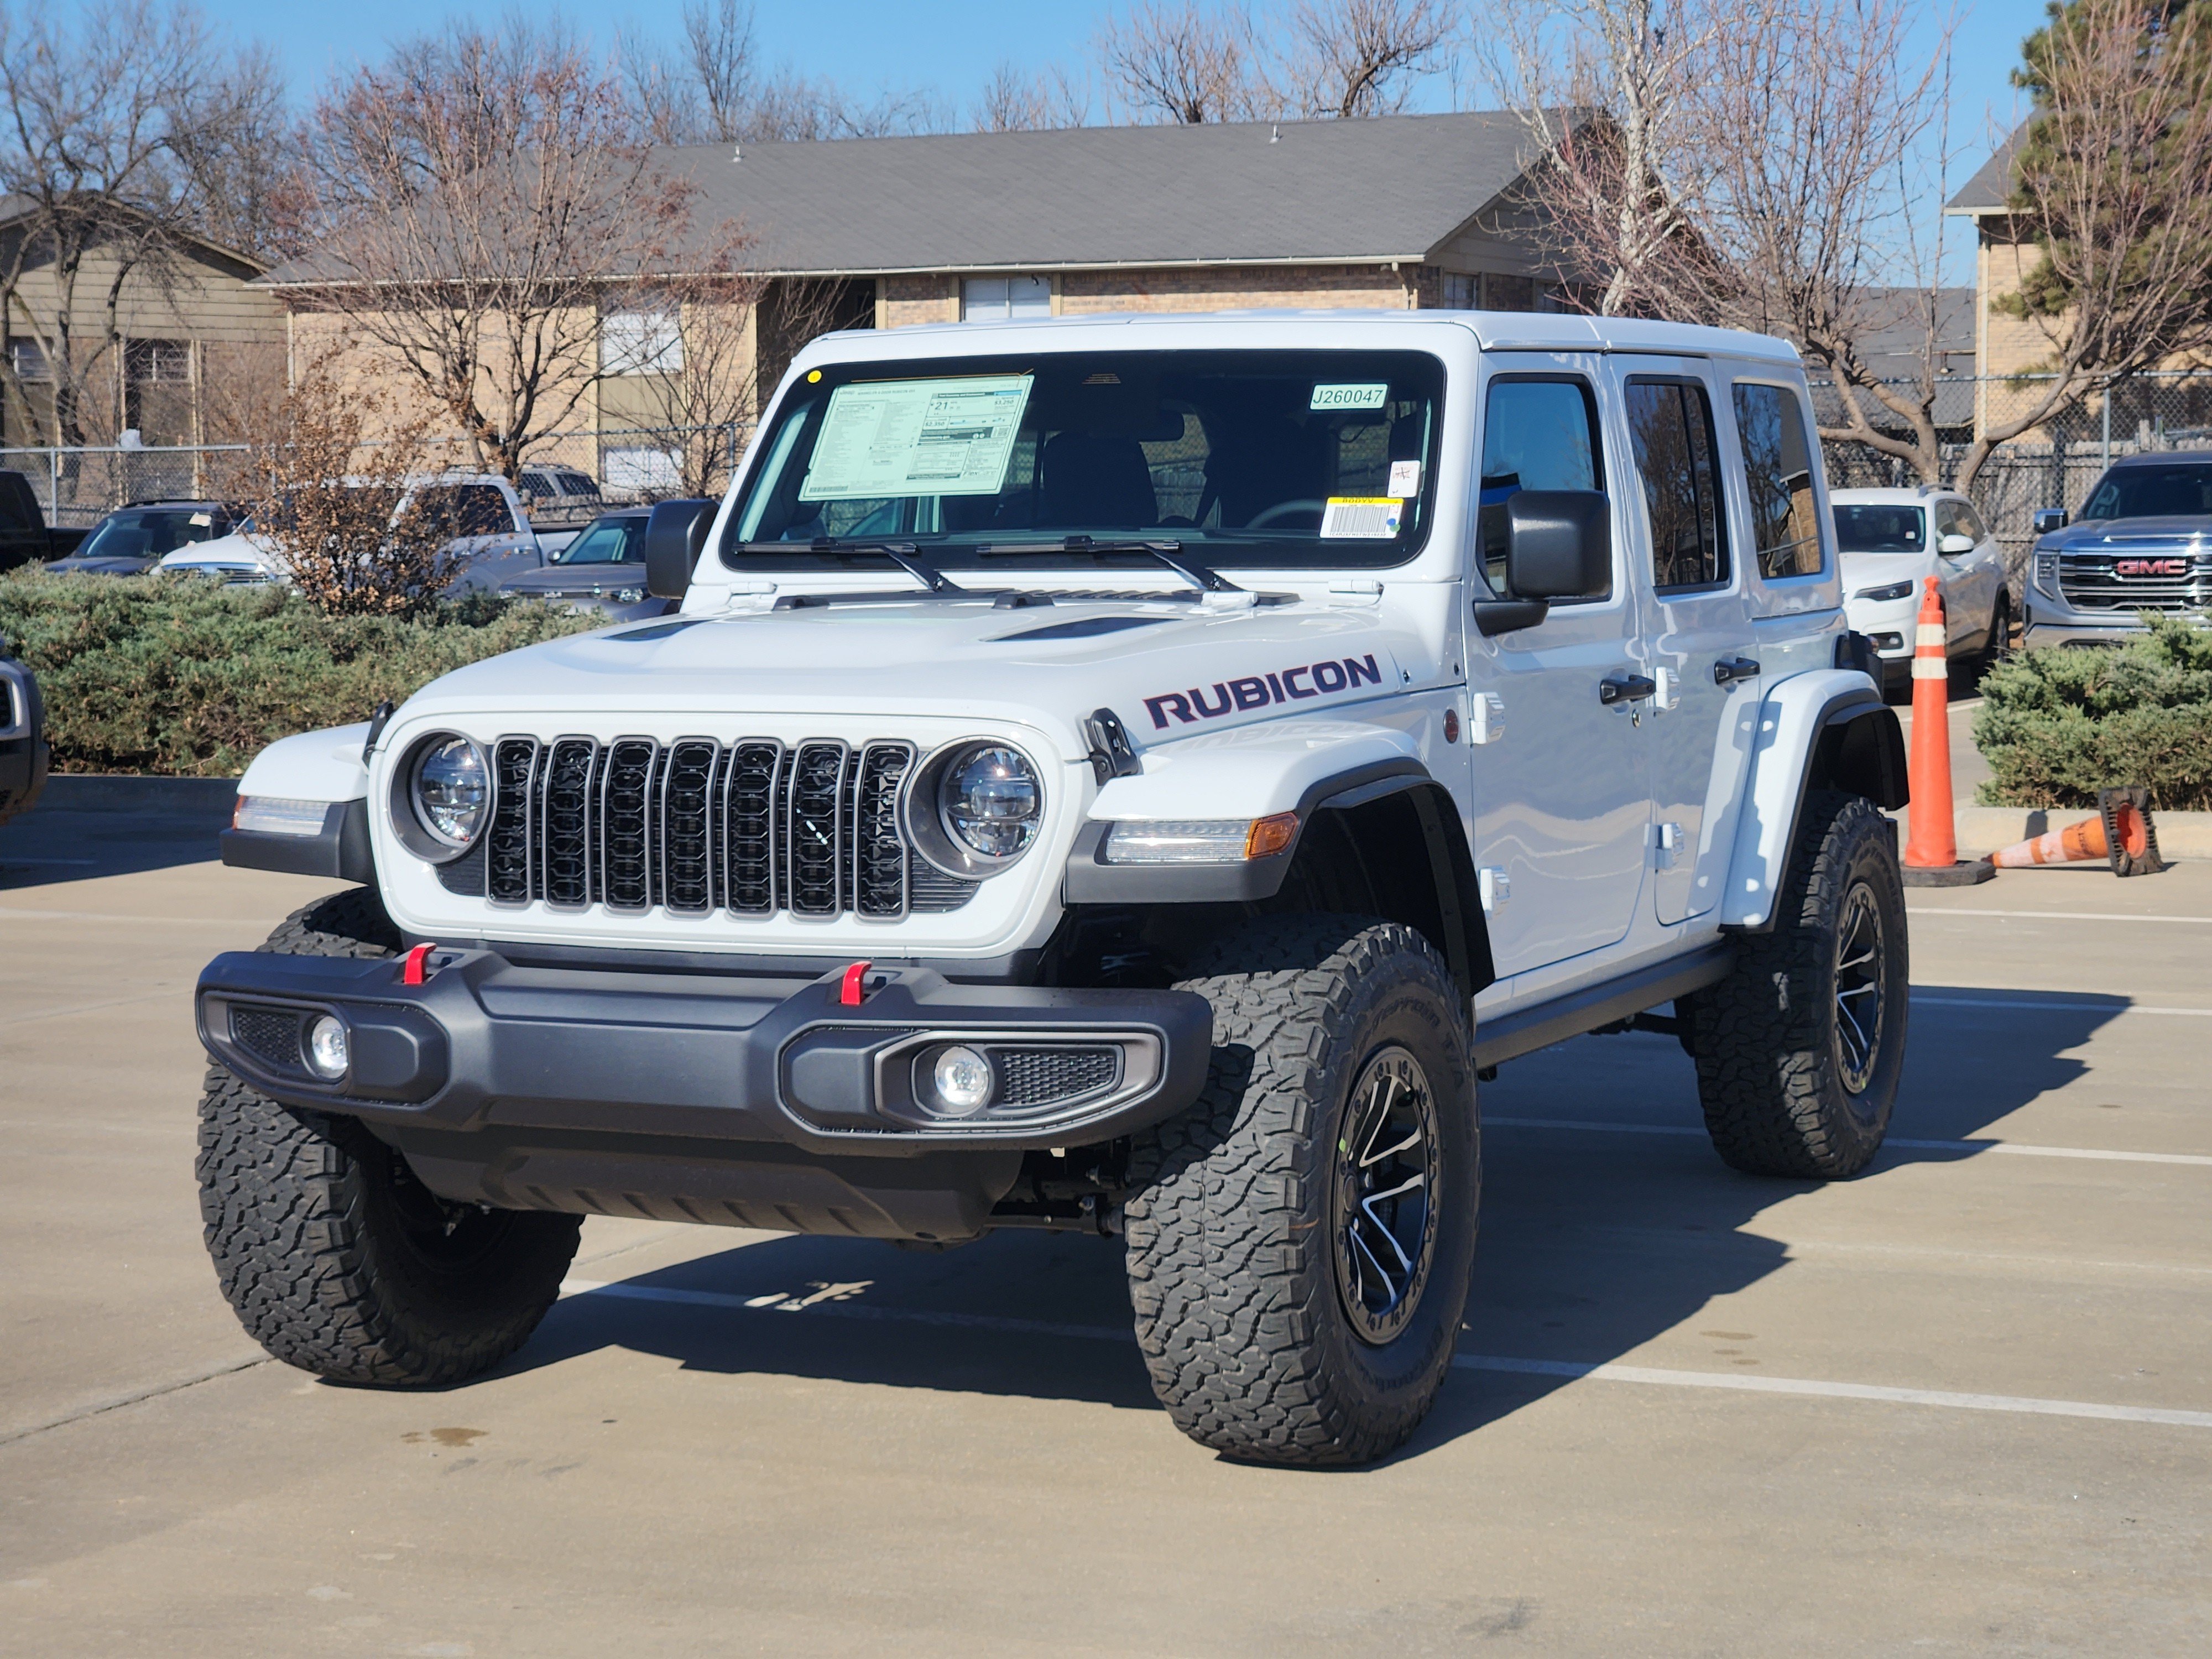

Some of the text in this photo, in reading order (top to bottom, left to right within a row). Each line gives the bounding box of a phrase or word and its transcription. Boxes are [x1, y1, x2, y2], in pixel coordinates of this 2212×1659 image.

[1313, 390, 1384, 404] J260047
[935, 401, 948, 410] 21
[2117, 560, 2186, 574] GMC
[1142, 654, 1382, 730] RUBICON
